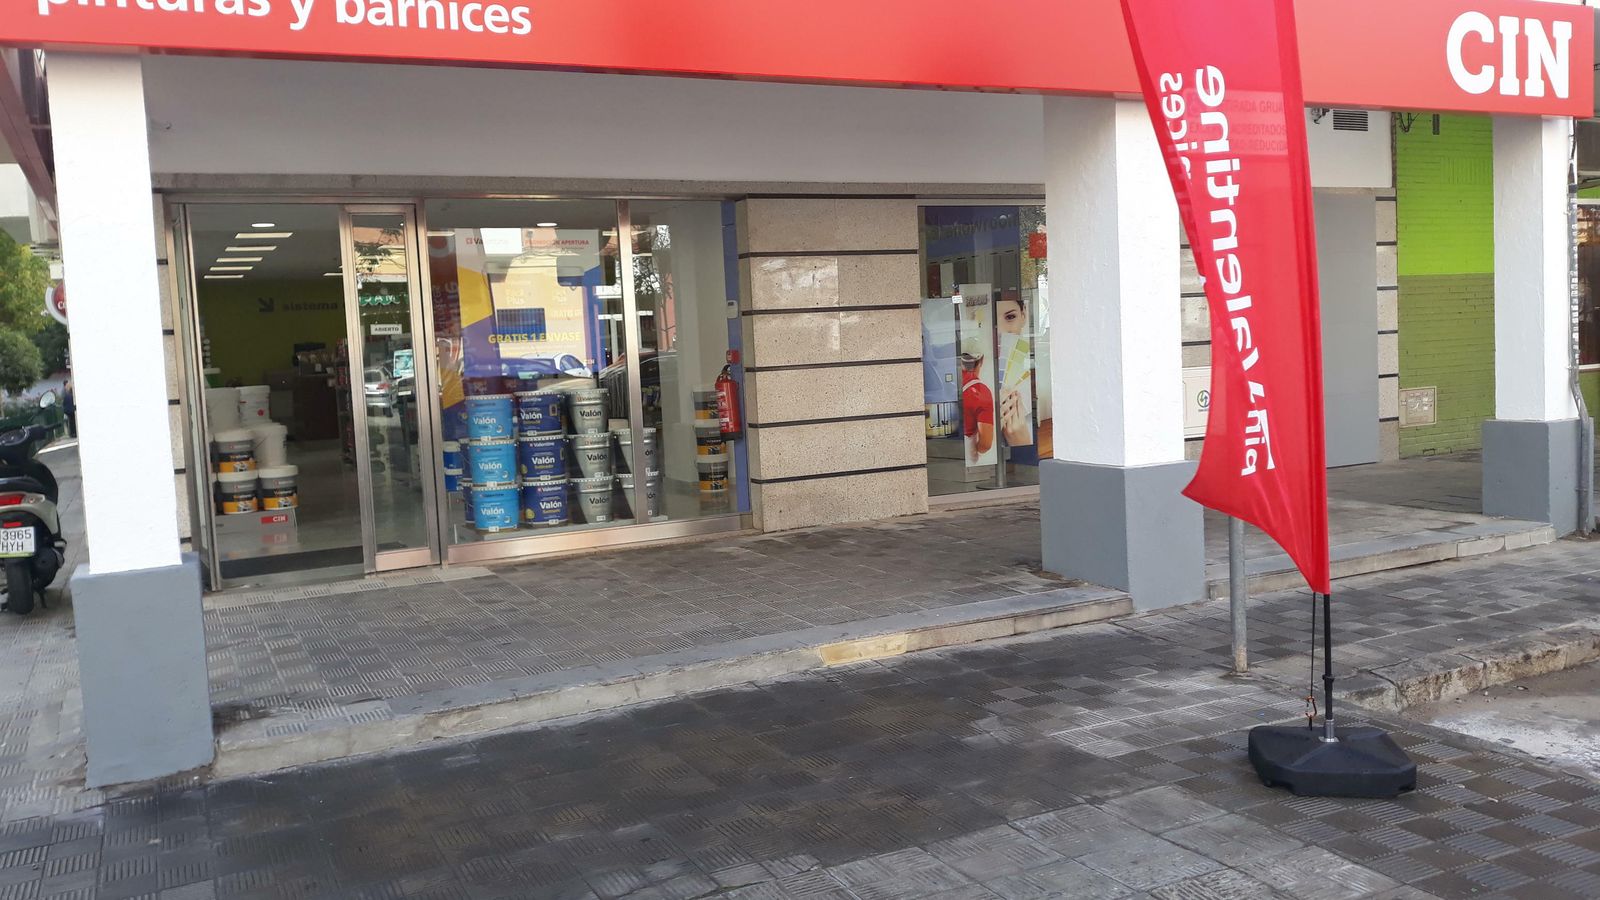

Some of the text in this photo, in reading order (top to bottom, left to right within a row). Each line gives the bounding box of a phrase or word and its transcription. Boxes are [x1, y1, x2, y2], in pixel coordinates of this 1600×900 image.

[336, 0, 532, 35] barnices
[1446, 11, 1573, 99] CIN
[487, 333, 529, 344] GRATIS
[540, 332, 581, 341] ENVASE
[520, 411, 543, 420] Valón
[580, 409, 602, 418] Valón
[473, 416, 497, 425] Valón
[531, 456, 556, 465] Valón
[478, 461, 503, 471] Valón
[540, 500, 563, 510] Valón
[481, 506, 505, 516] Valón
[2, 529, 32, 541] 3965
[1, 541, 24, 552] HYH
